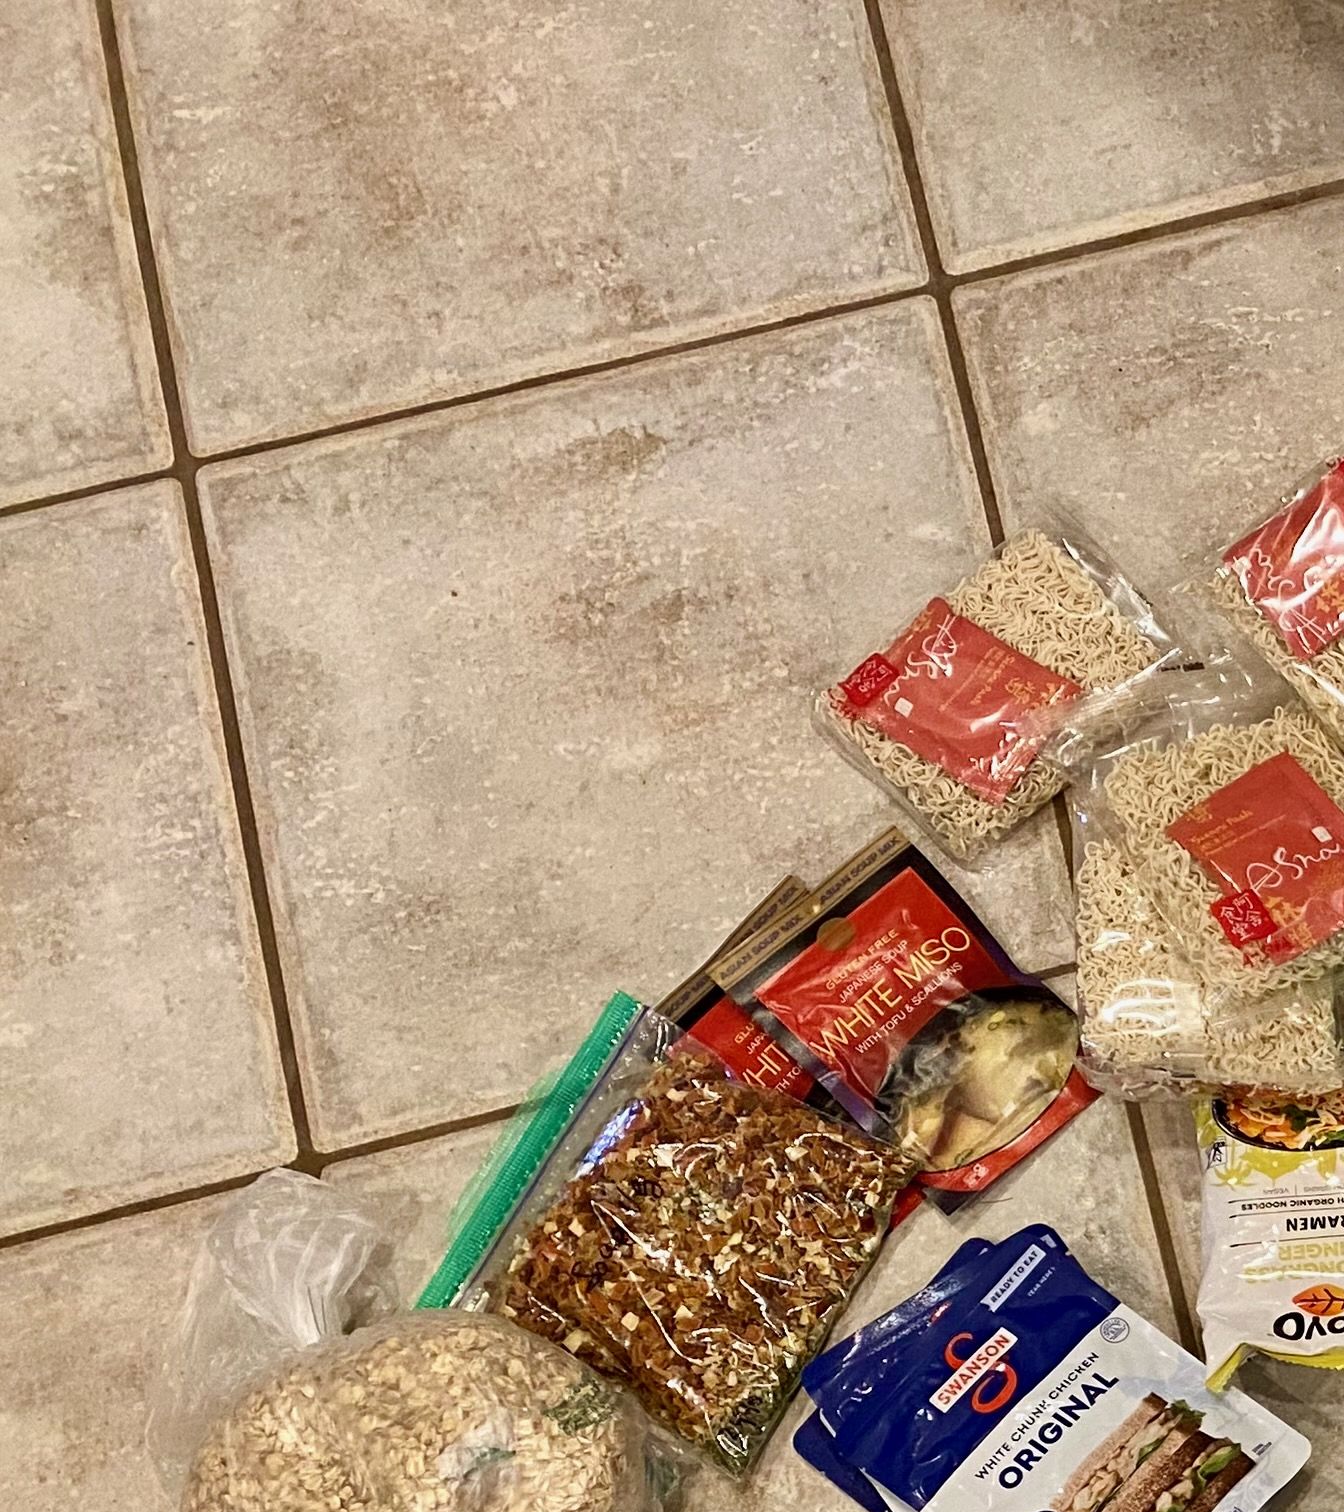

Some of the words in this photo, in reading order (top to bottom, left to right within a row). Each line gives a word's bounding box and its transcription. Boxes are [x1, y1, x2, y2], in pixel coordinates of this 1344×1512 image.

[811, 978, 902, 1060] WHITE
[894, 927, 970, 992] MISO
[826, 952, 869, 991] GLUTEN
[869, 929, 898, 956] FREE
[840, 962, 882, 1004] JAPANESE
[881, 940, 908, 965] SOUP
[855, 1034, 880, 1055] WITH
[879, 1011, 906, 1038] TOFU
[912, 962, 963, 1006] SCALLIONS
[1241, 1200, 1291, 1211] NOODLES
[1294, 1196, 1334, 1208] ORGANIC
[990, 1276, 1015, 1303] READY
[1013, 1267, 1025, 1279] TO
[1023, 1250, 1039, 1269] EAT
[937, 1335, 1010, 1406] SWANSON
[975, 1444, 1011, 1480] WHITE
[1011, 1399, 1052, 1441] CHUNK
[1049, 1352, 1099, 1399] CHICKEN
[999, 1372, 1119, 1490] ORIGINAL
